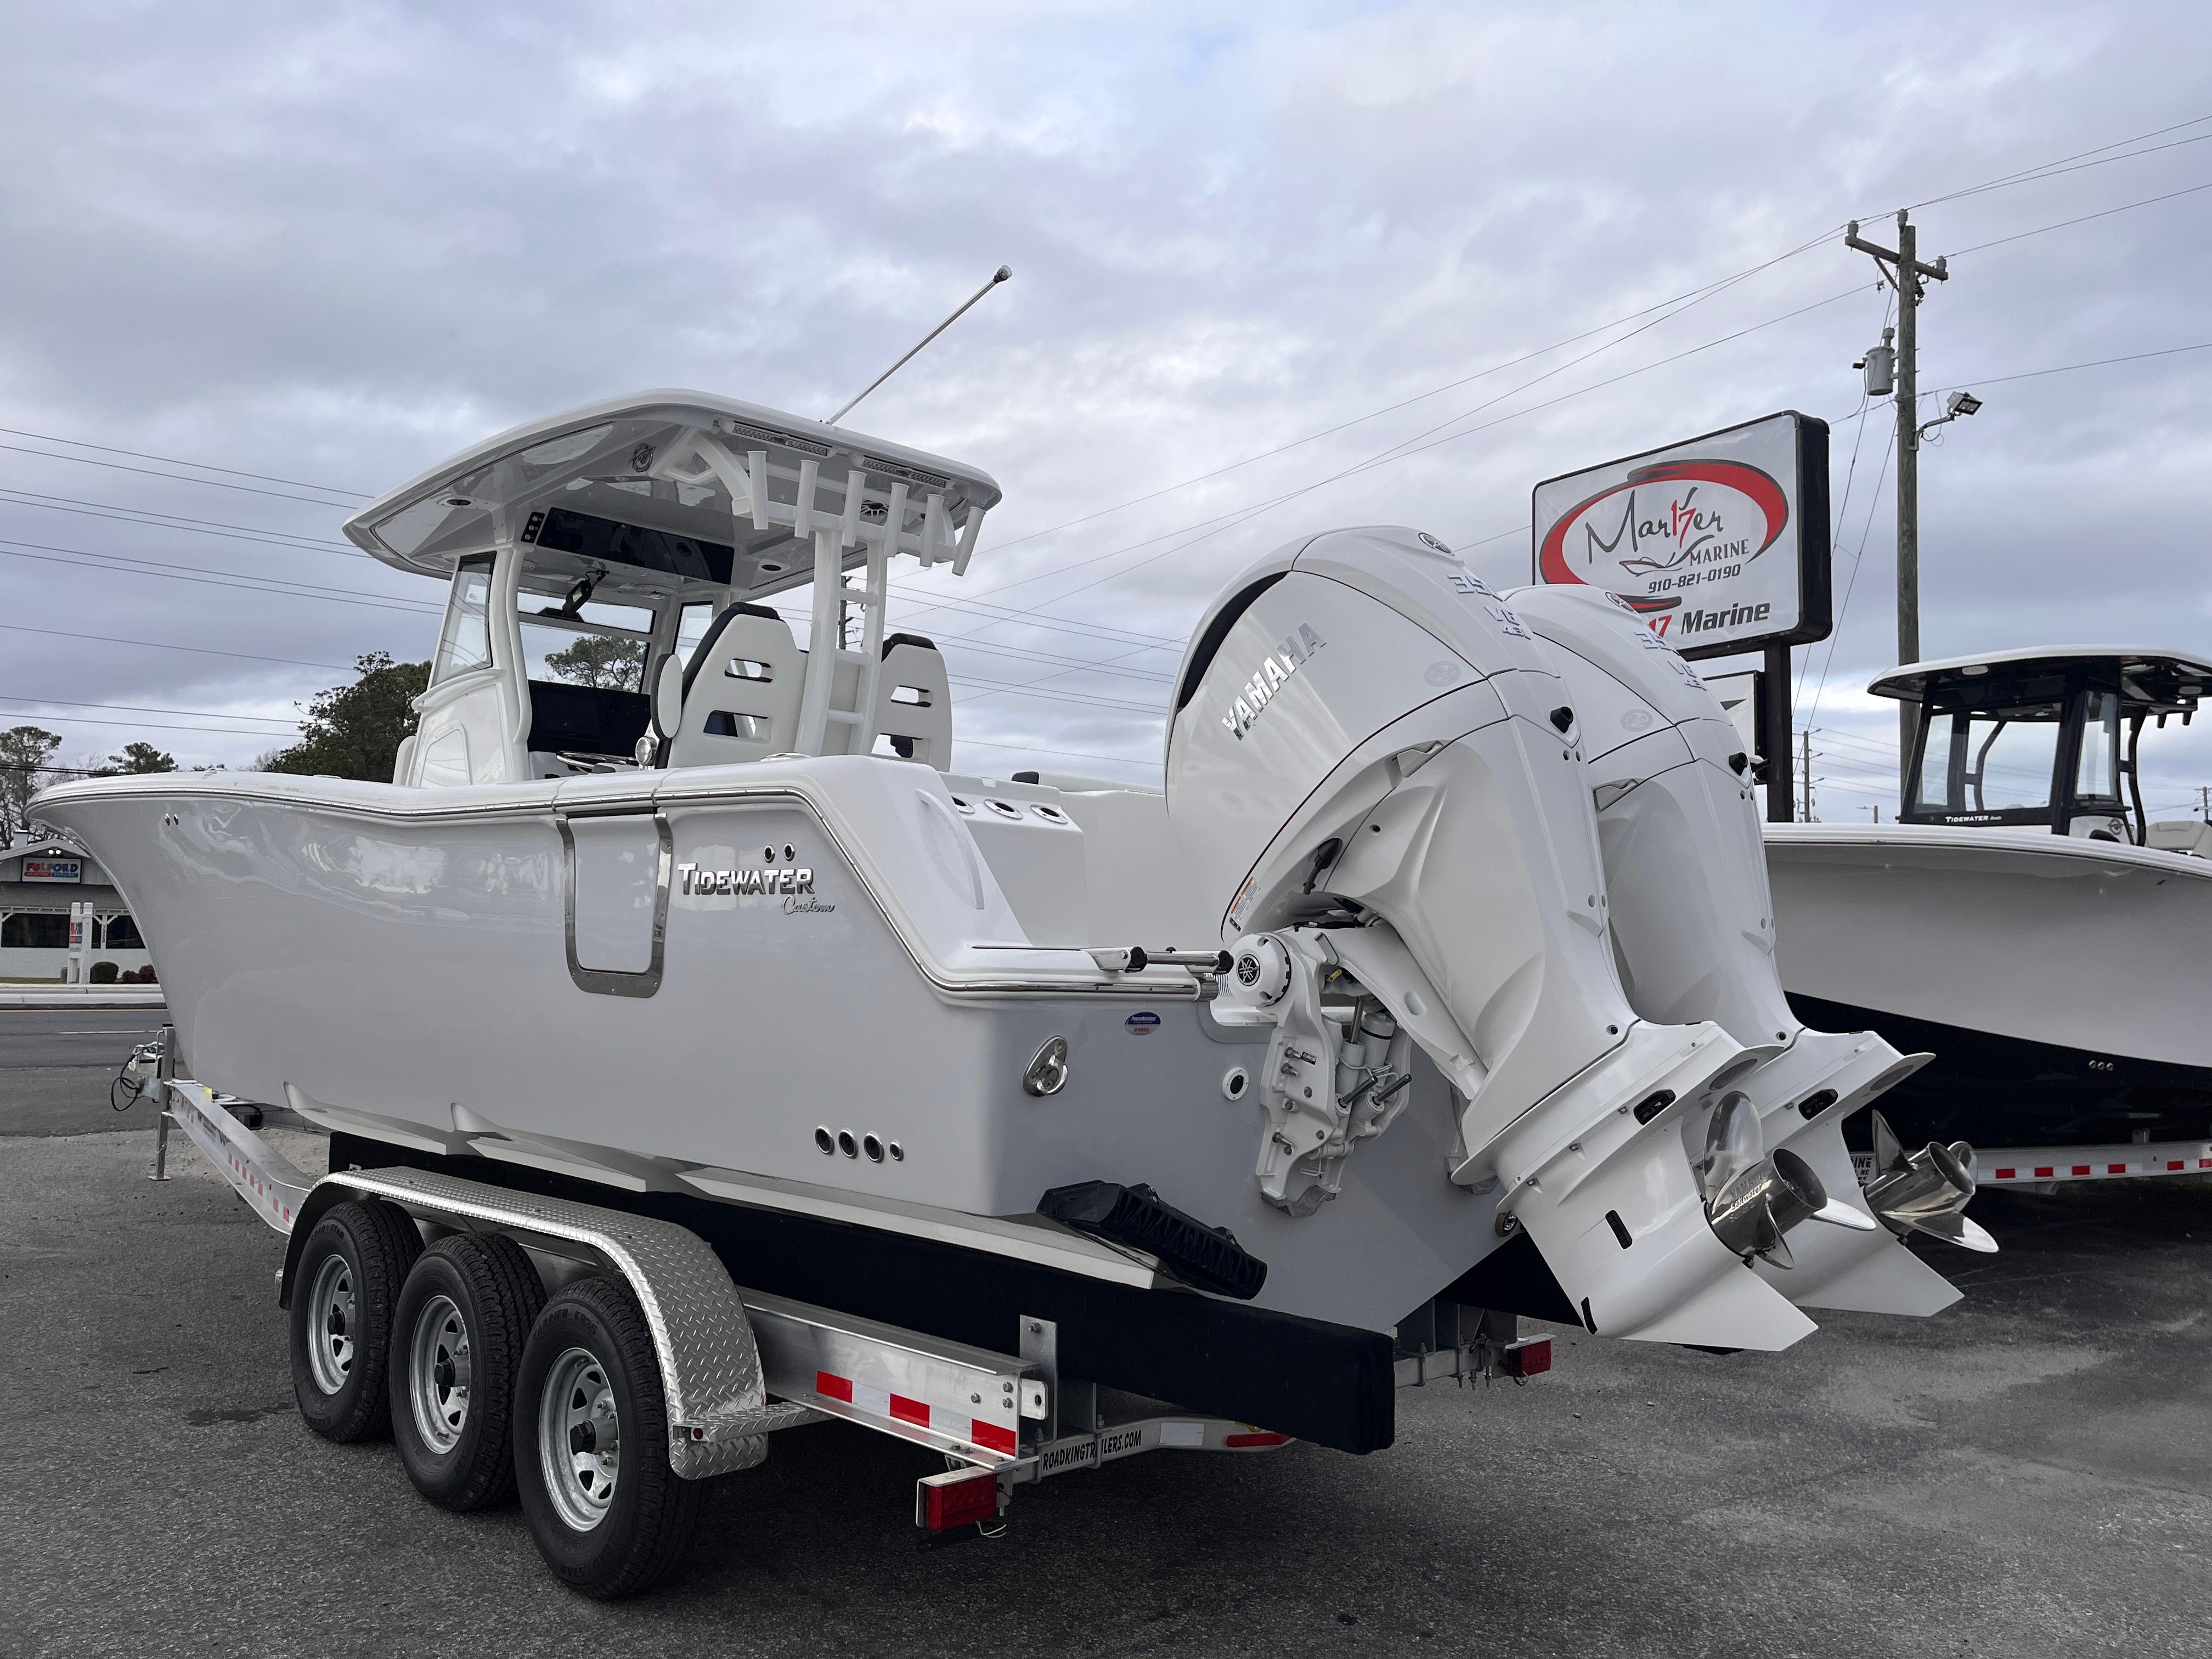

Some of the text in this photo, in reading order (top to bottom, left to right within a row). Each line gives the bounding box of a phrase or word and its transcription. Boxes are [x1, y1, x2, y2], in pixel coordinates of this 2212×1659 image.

[1689, 539, 1750, 566] MARINE
[1647, 564, 1741, 594] 910-821-0190
[1680, 602, 1770, 635] Marine
[1221, 622, 1327, 741] YAMAHA
[678, 862, 815, 895] TIDEWATER
[781, 894, 835, 915] Custom
[1730, 1184, 1762, 1210] Saltwater
[1043, 1429, 1142, 1471] ROADKINGTRILERS.COM
